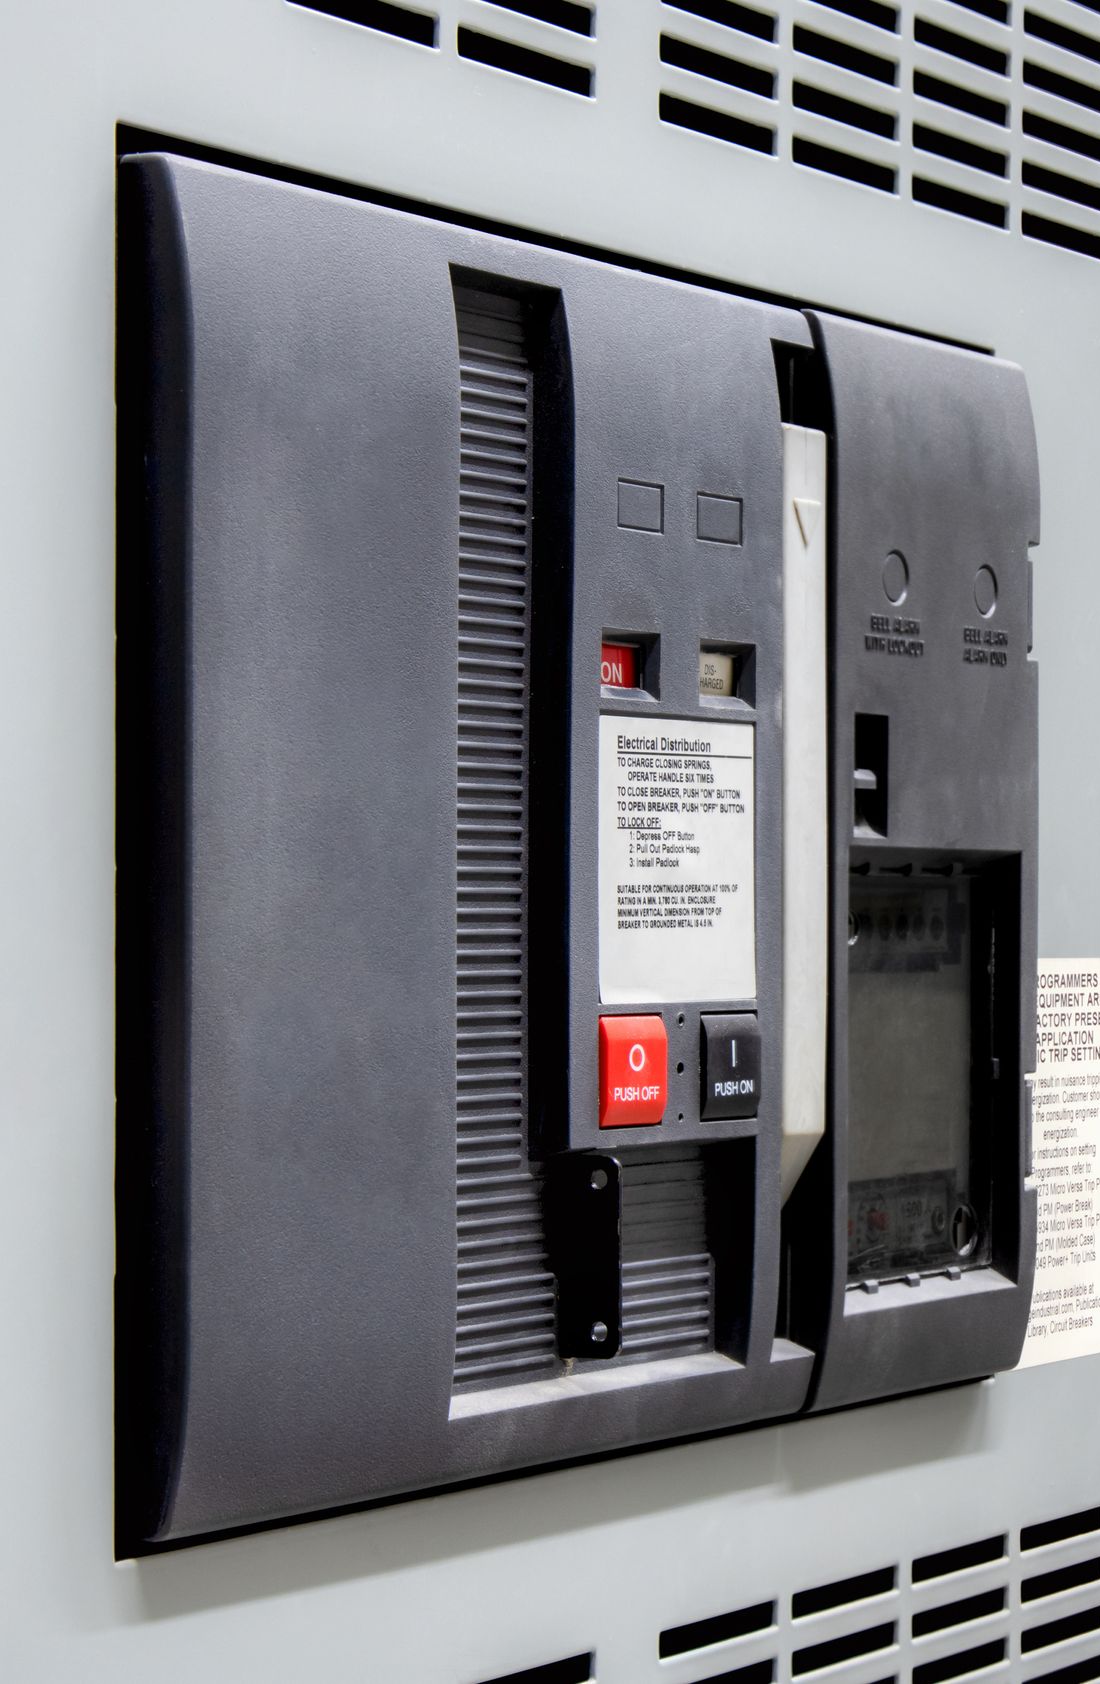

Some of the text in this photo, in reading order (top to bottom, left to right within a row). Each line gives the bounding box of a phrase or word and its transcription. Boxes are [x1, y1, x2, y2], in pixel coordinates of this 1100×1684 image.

[600, 661, 622, 684] ON
[700, 677, 724, 690] HARGED
[617, 735, 711, 752] Electrical Distribution
[617, 757, 626, 767] TO
[627, 757, 654, 768] CHARGE
[655, 758, 682, 769] CLOSING
[628, 771, 714, 784] OPERATE HANDLE SIX TIMES
[617, 786, 626, 797] TO
[627, 787, 648, 797] CLOSE
[683, 788, 699, 798] PUSH
[717, 789, 740, 799] BUTTON
[617, 801, 626, 811] TO
[628, 801, 646, 812] OPEN
[682, 803, 699, 813] PUSH
[720, 803, 744, 814] BUTTON
[617, 816, 626, 827] TO
[628, 817, 645, 827] LOCK
[636, 831, 662, 842] Depress
[662, 831, 676, 841] OFF
[677, 832, 694, 841] Button
[636, 843, 648, 854] Pull
[649, 844, 661, 854] Out
[662, 844, 685, 854] Padlock
[686, 846, 700, 855] Hasp
[637, 858, 654, 868] Install
[656, 858, 679, 868] Padlock
[1037, 993, 1085, 1008] QUIPMENT
[1036, 1013, 1072, 1028] ACTORY
[1049, 1048, 1068, 1062] TRIP
[614, 1086, 660, 1101] PUSH OFF
[715, 1079, 753, 1097] PUSH ON
